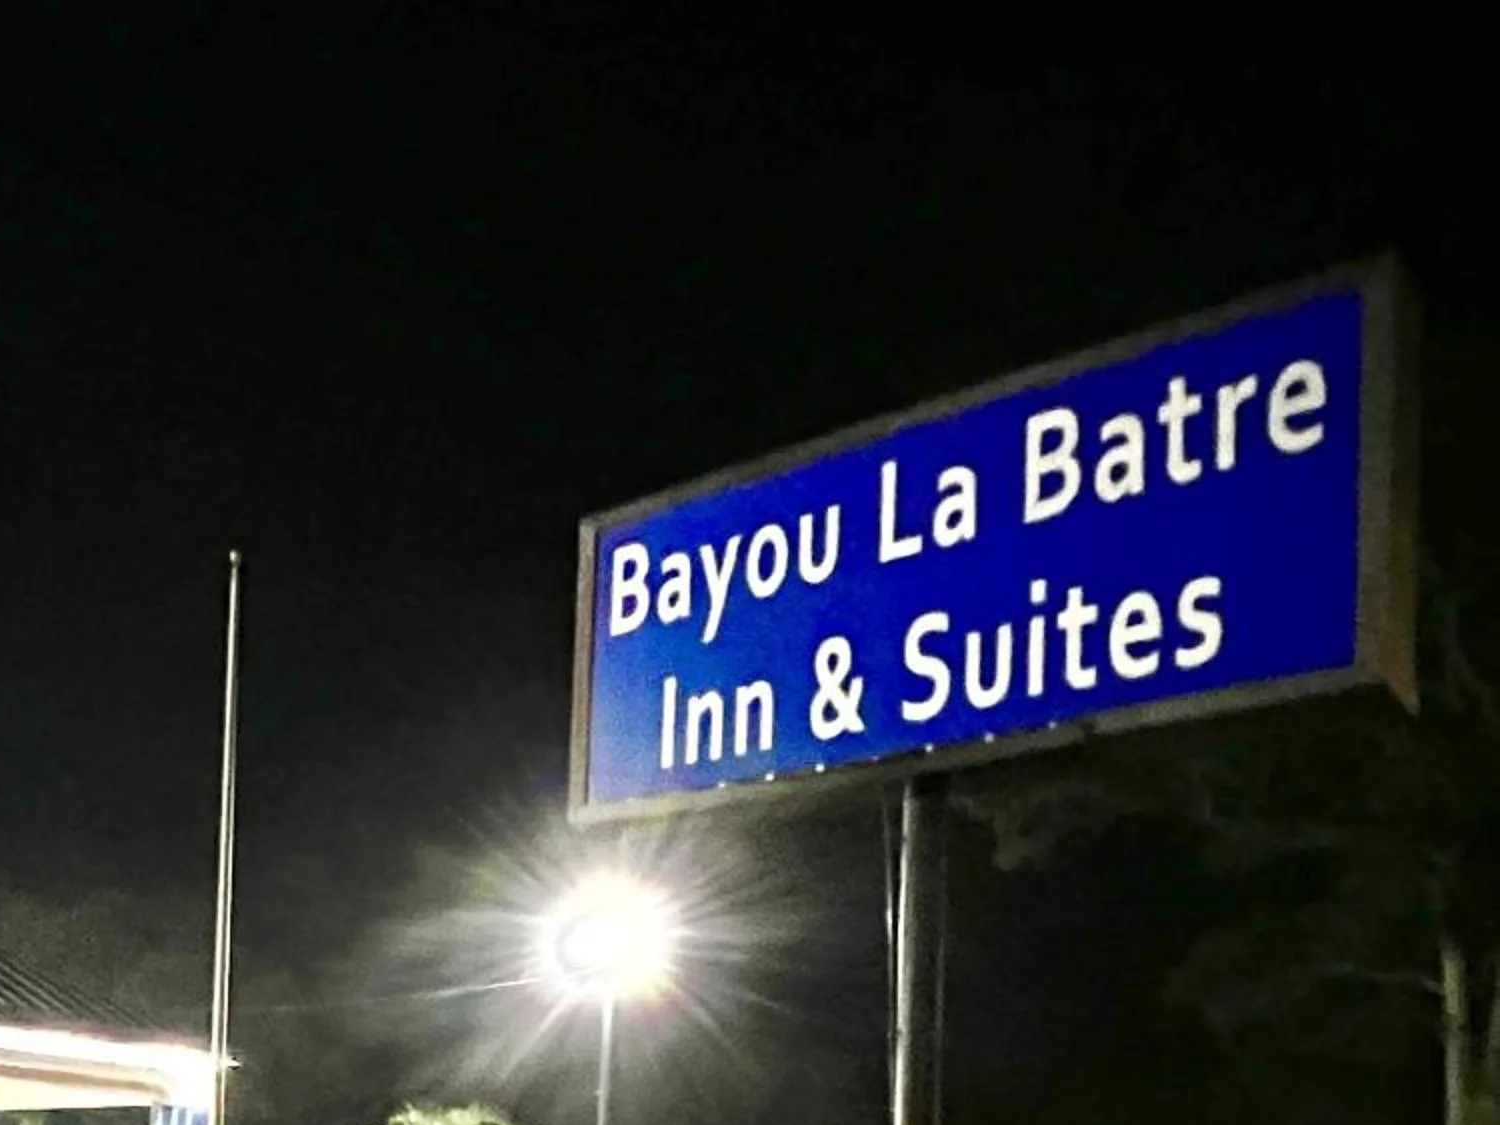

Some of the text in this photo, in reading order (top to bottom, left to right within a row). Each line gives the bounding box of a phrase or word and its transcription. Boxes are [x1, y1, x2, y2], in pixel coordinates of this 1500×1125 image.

[607, 359, 1327, 644] Bayou La Batre
[658, 576, 1224, 772] Inn & Suites
